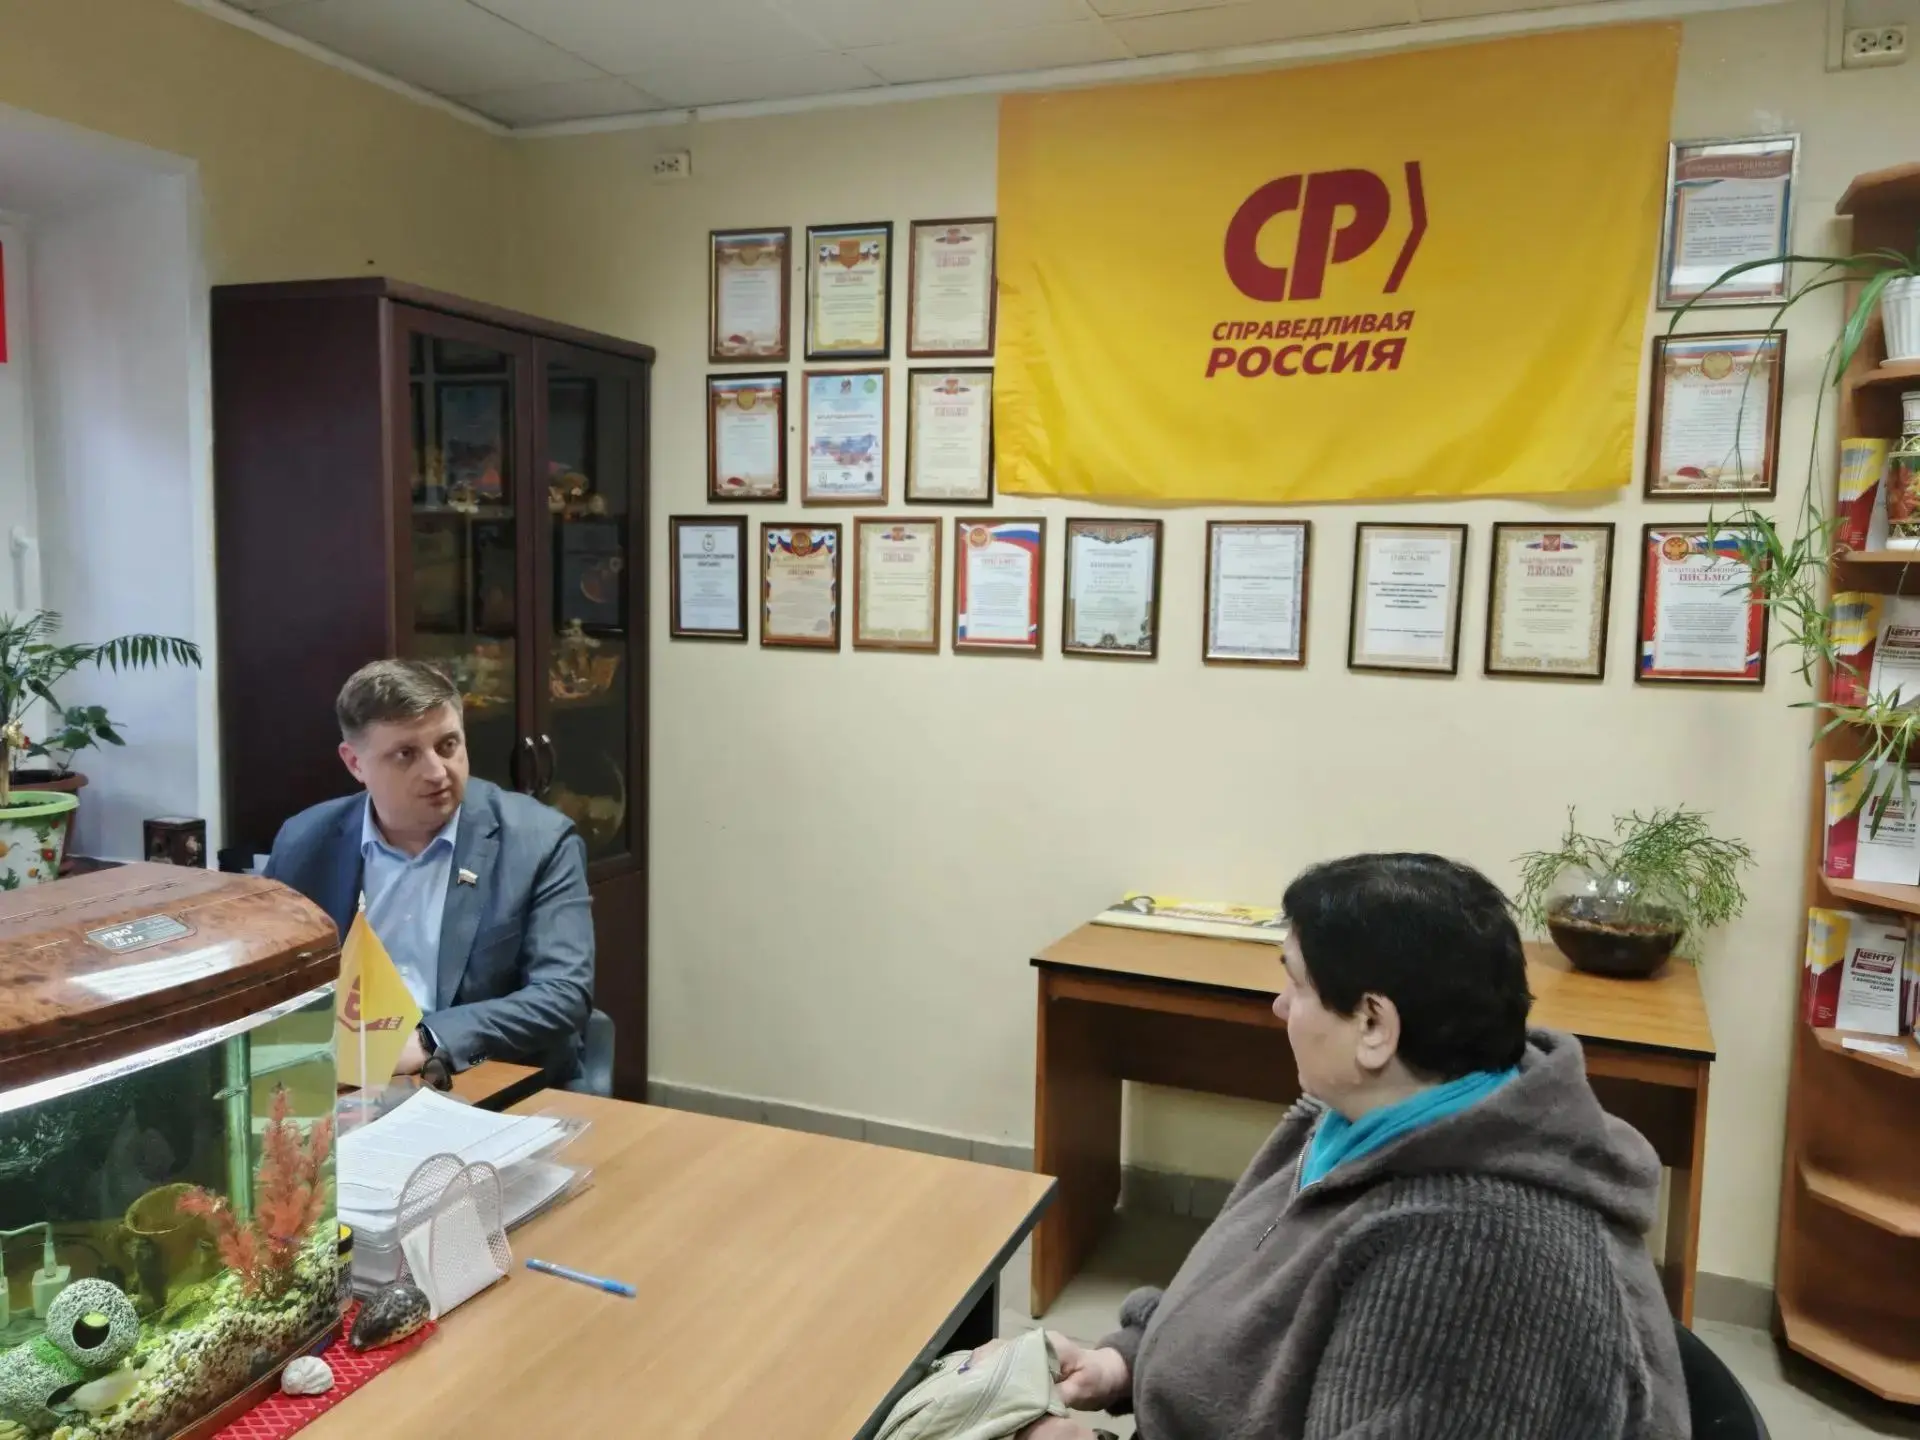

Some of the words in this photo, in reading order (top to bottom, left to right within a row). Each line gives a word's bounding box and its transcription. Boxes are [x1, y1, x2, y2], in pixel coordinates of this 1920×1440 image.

[1212, 310, 1415, 341] СПРАВЕДЛИВАЯ
[1205, 337, 1407, 378] РОССИЯ
[1859, 951, 1895, 962] ЦЕНТР
